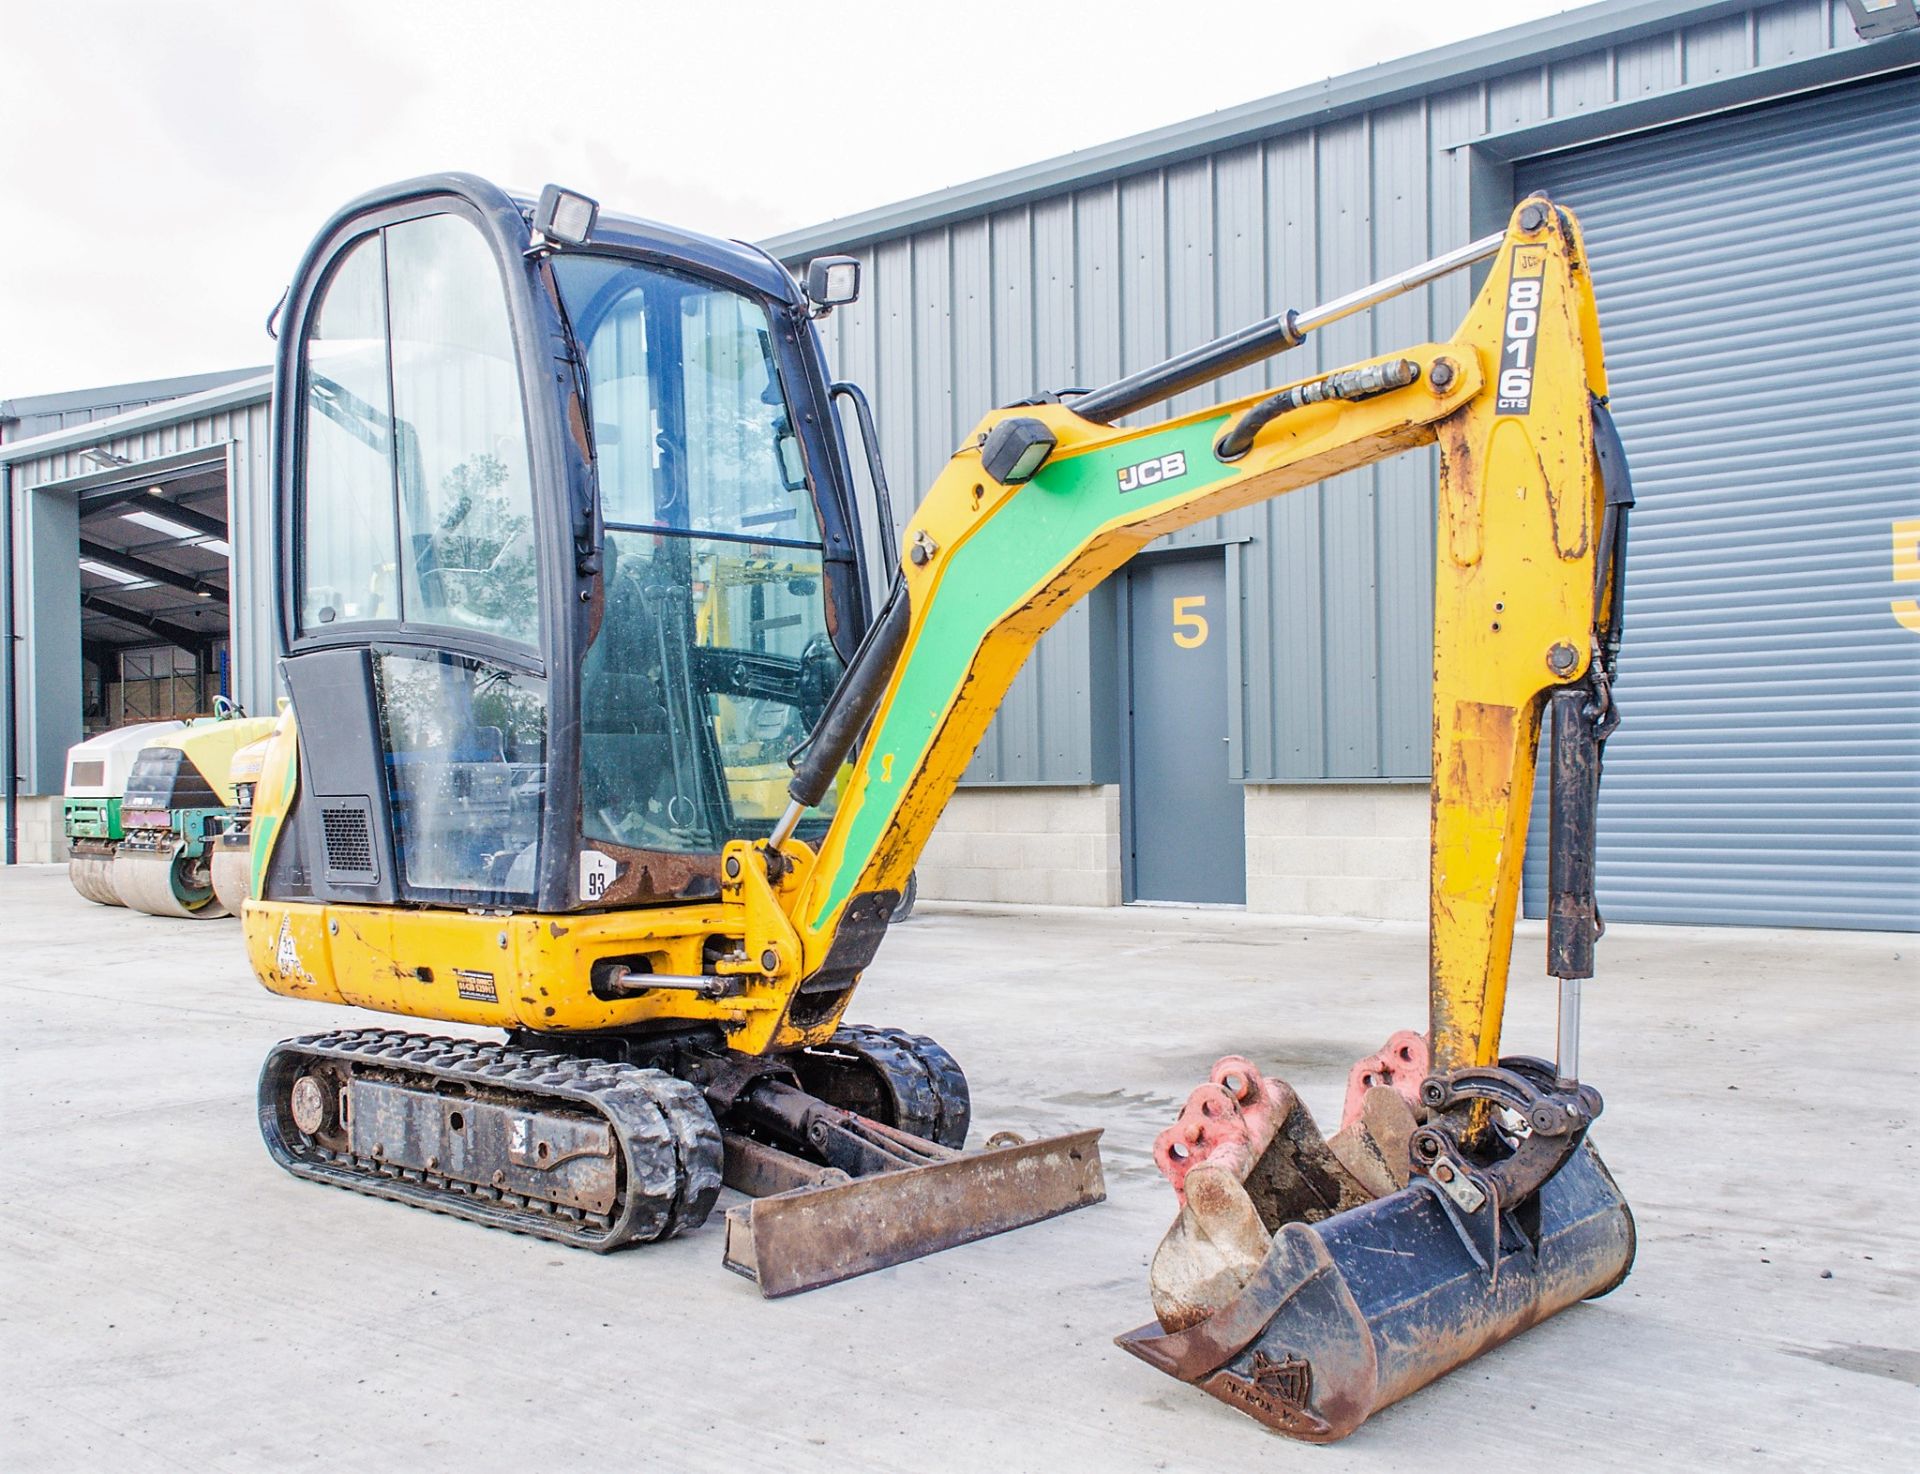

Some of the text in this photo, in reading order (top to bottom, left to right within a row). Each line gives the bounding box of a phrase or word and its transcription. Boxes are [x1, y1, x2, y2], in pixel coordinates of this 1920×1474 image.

[1499, 280, 1541, 398] 8016
[1498, 398, 1528, 409] CTS
[1118, 452, 1186, 491] JCB
[1173, 595, 1209, 649] 5
[589, 872, 605, 896] 93
